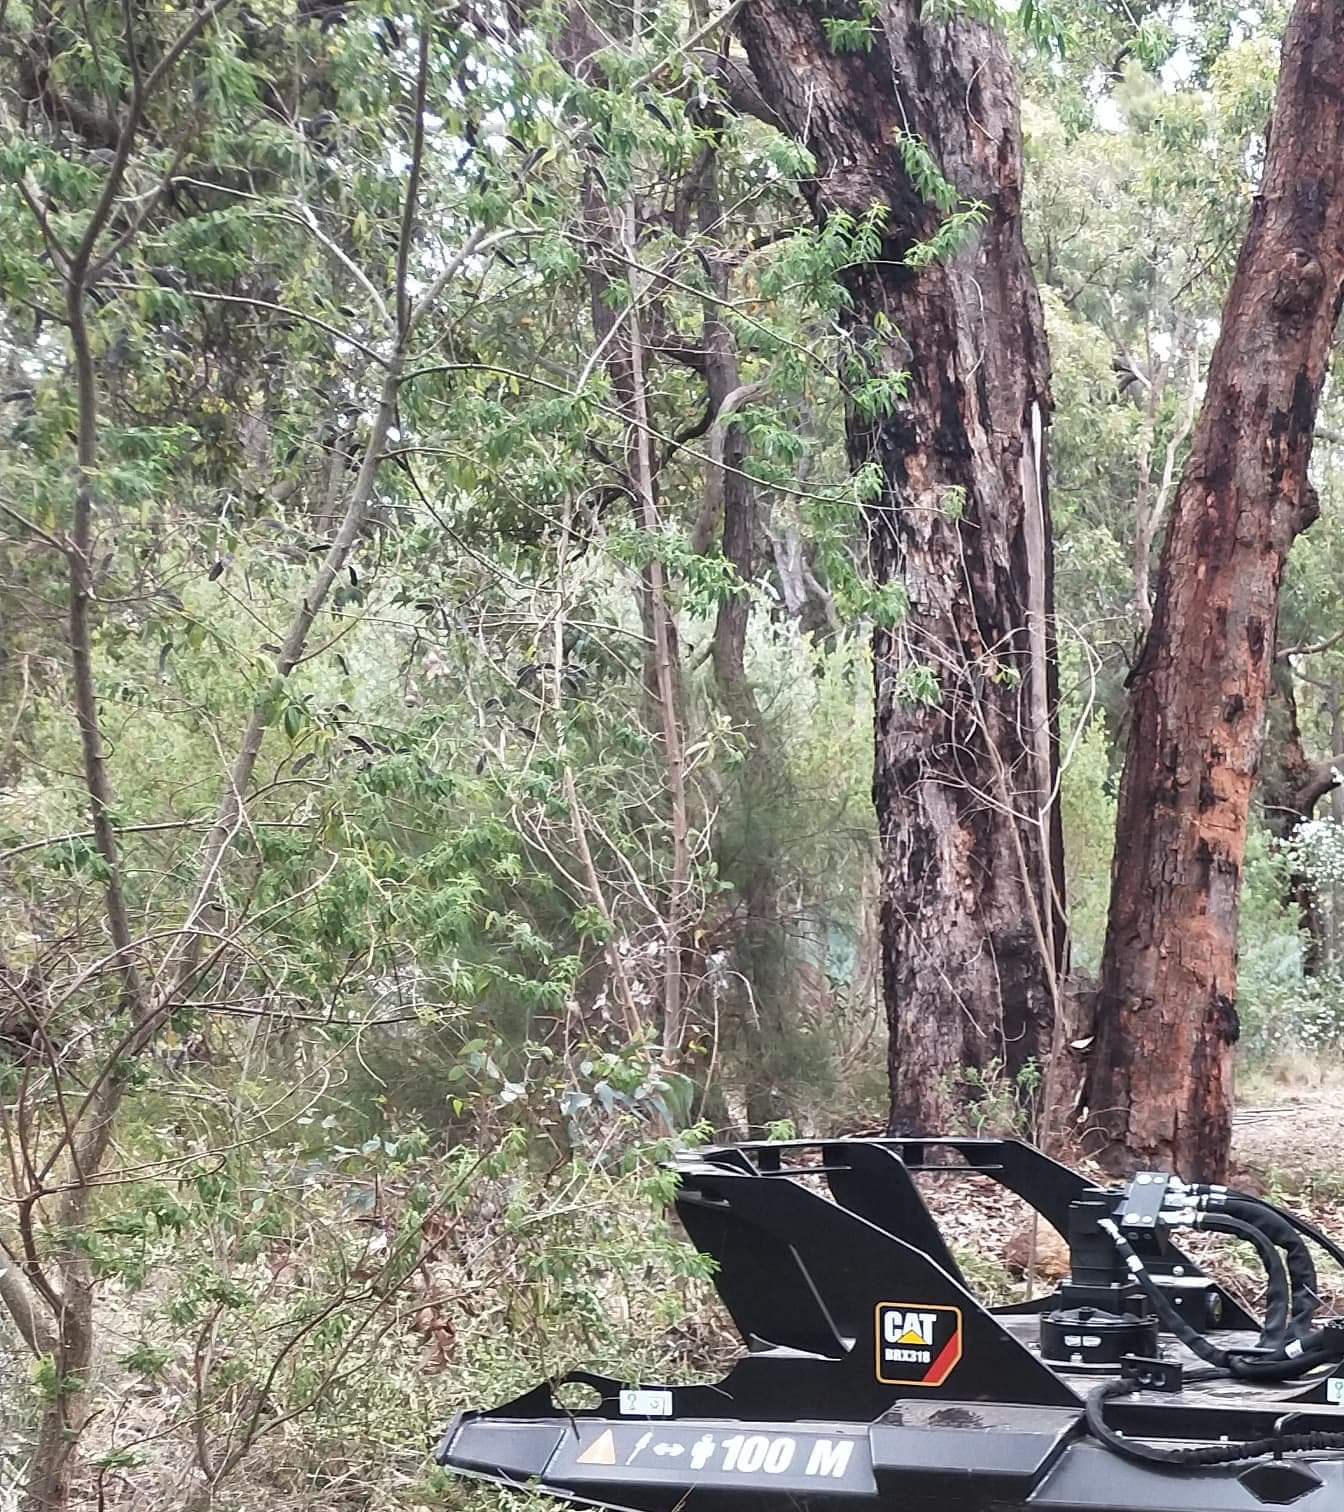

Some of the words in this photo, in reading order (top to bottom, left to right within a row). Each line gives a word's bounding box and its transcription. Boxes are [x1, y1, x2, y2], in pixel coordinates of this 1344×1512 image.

[884, 1310, 937, 1345] CAT
[720, 1434, 796, 1474] 100
[805, 1439, 854, 1478] M
